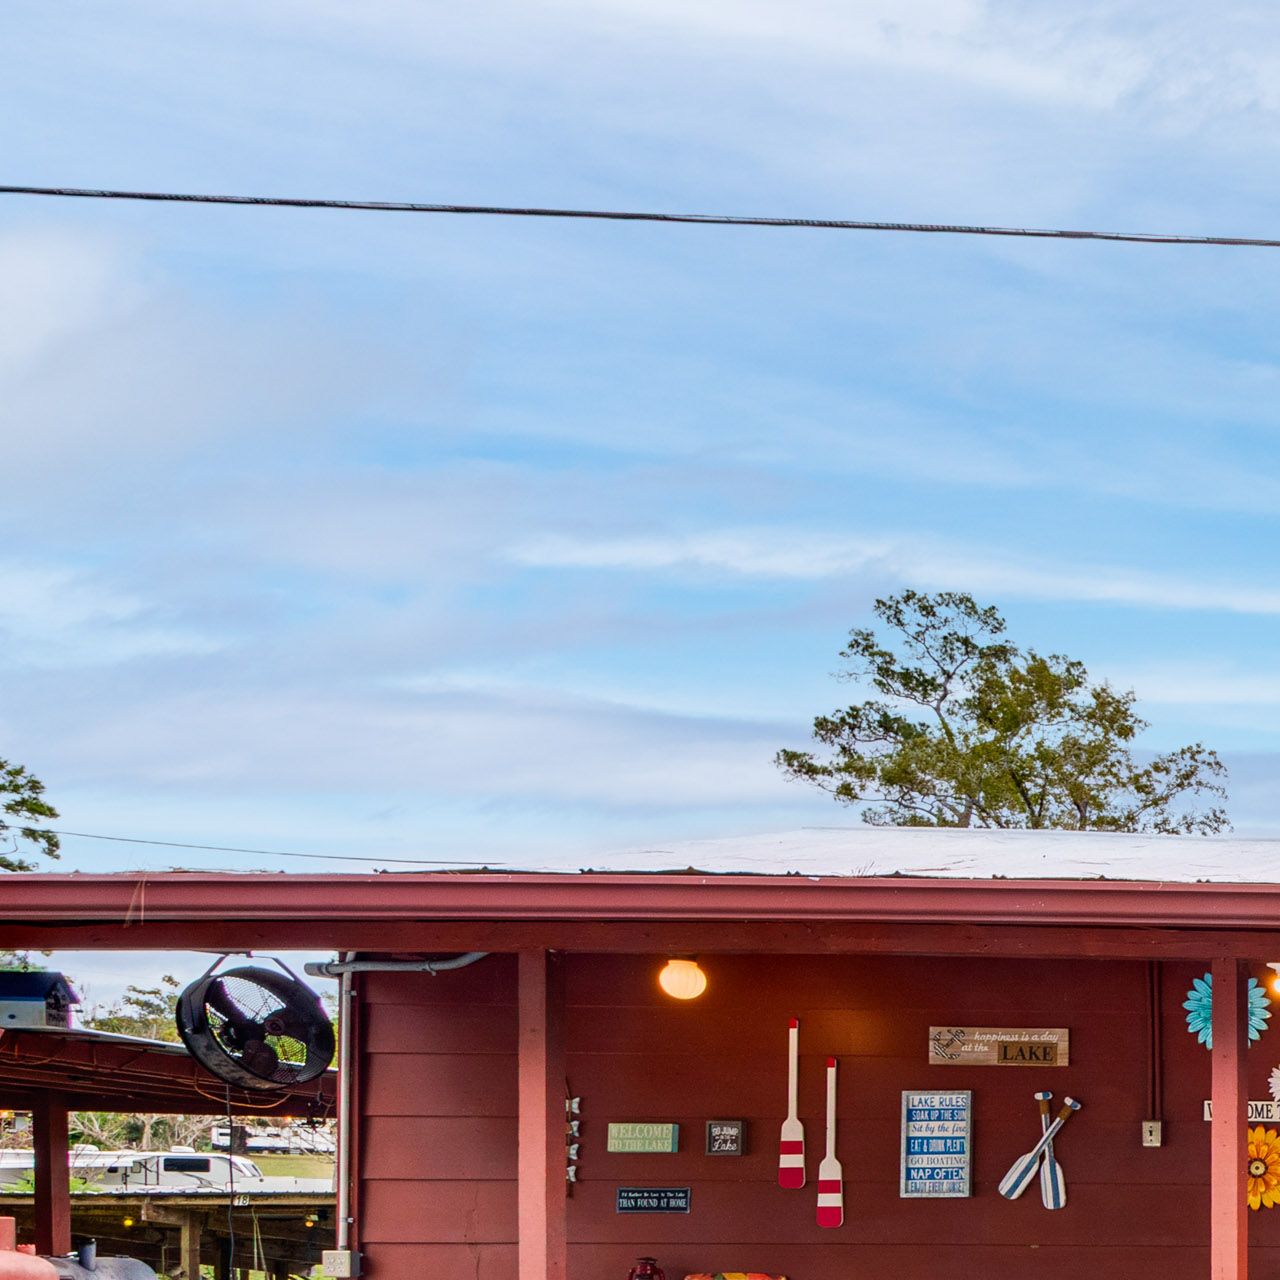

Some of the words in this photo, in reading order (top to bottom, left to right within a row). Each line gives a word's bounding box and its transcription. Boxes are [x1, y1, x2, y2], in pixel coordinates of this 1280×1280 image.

[974, 1032, 1018, 1042] happiness
[1021, 1032, 1029, 1041] is
[1040, 1032, 1058, 1042] day
[1003, 1046, 1053, 1060] LAKE
[912, 1097, 934, 1108] LAKE
[940, 1097, 967, 1108] RULES
[912, 1110, 929, 1120] SOAK
[930, 1110, 940, 1120] UP
[941, 1110, 952, 1120] THE
[609, 1125, 672, 1138] WELCOME
[912, 1124, 922, 1132] Sit
[926, 1124, 934, 1134] by
[938, 1124, 949, 1132] the
[644, 1140, 672, 1150] LAKE
[712, 1140, 737, 1151] Lake
[910, 1140, 922, 1152] EAT
[910, 1156, 923, 1165] GO
[927, 1156, 968, 1166] BOATING
[911, 1169, 931, 1179] NAP
[934, 1169, 965, 1179] OFTEN
[620, 1199, 635, 1208] THAN
[637, 1199, 658, 1208] FOUND
[661, 1199, 668, 1208] AT
[670, 1199, 687, 1208] HOME
